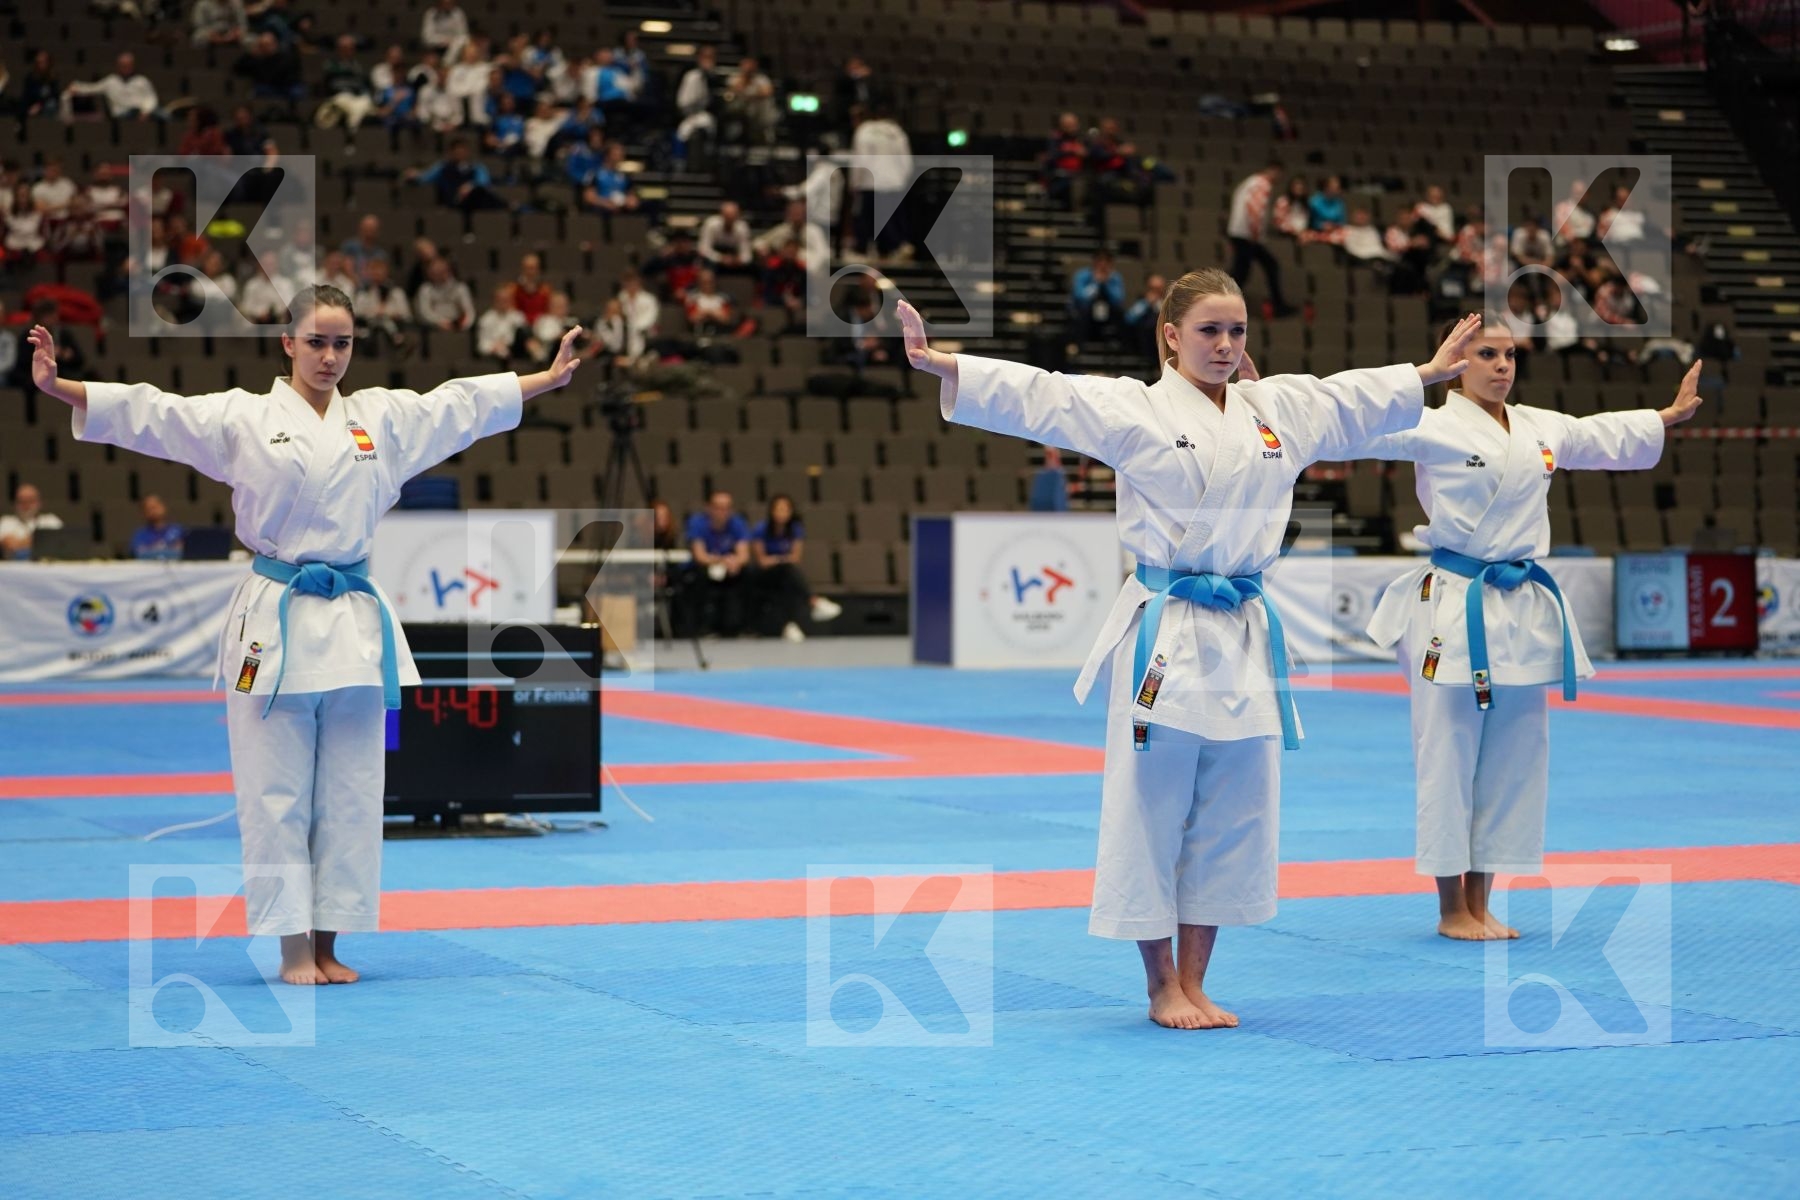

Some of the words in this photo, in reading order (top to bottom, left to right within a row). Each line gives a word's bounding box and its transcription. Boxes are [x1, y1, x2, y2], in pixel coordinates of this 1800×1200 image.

[1710, 577, 1737, 626] 2
[414, 684, 498, 729] 4:40
[534, 687, 589, 703] Female
